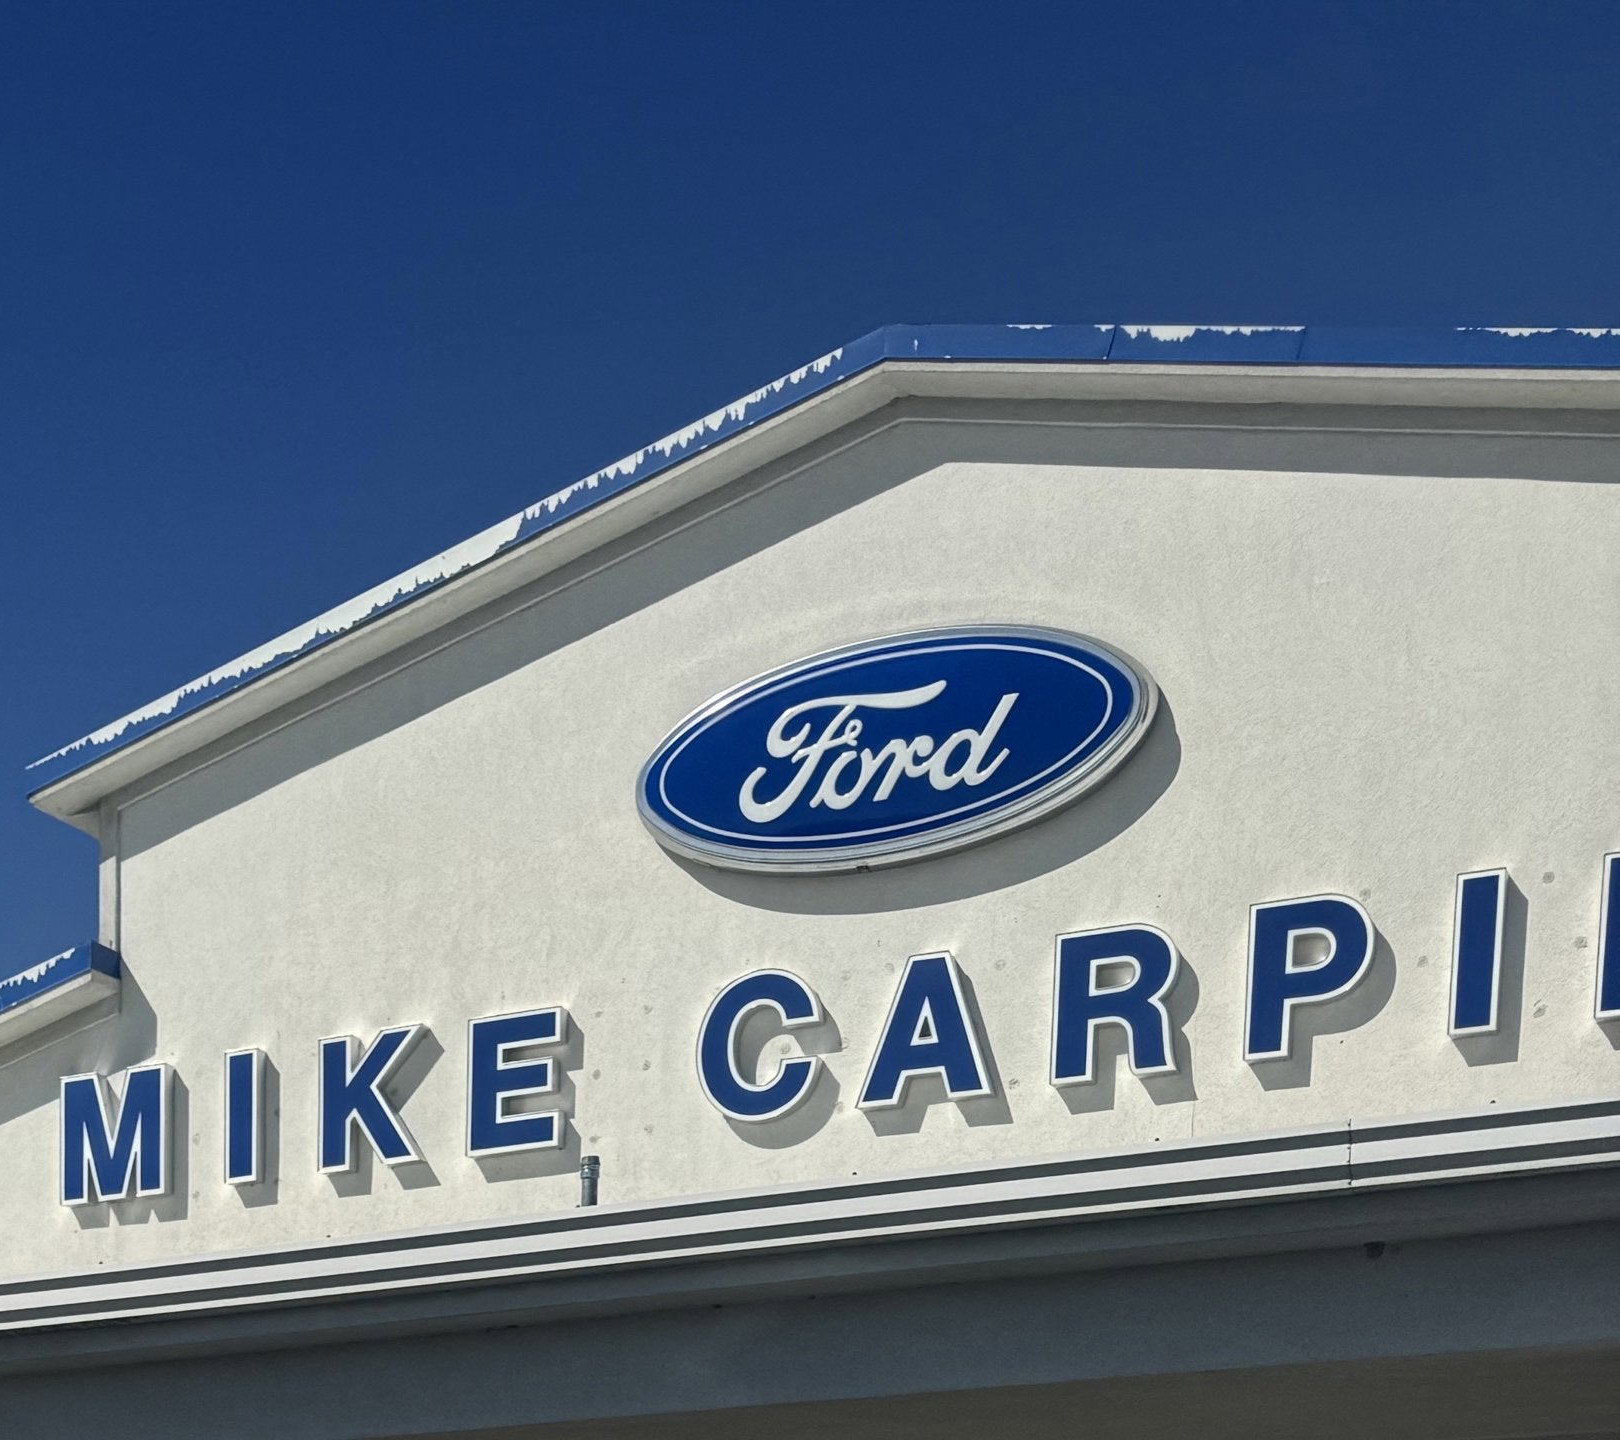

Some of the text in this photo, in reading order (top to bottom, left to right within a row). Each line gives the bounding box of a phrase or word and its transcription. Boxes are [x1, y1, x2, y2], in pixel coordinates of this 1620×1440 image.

[738, 679, 1020, 823] Ford
[59, 852, 1620, 1207] MIKE CARPI
